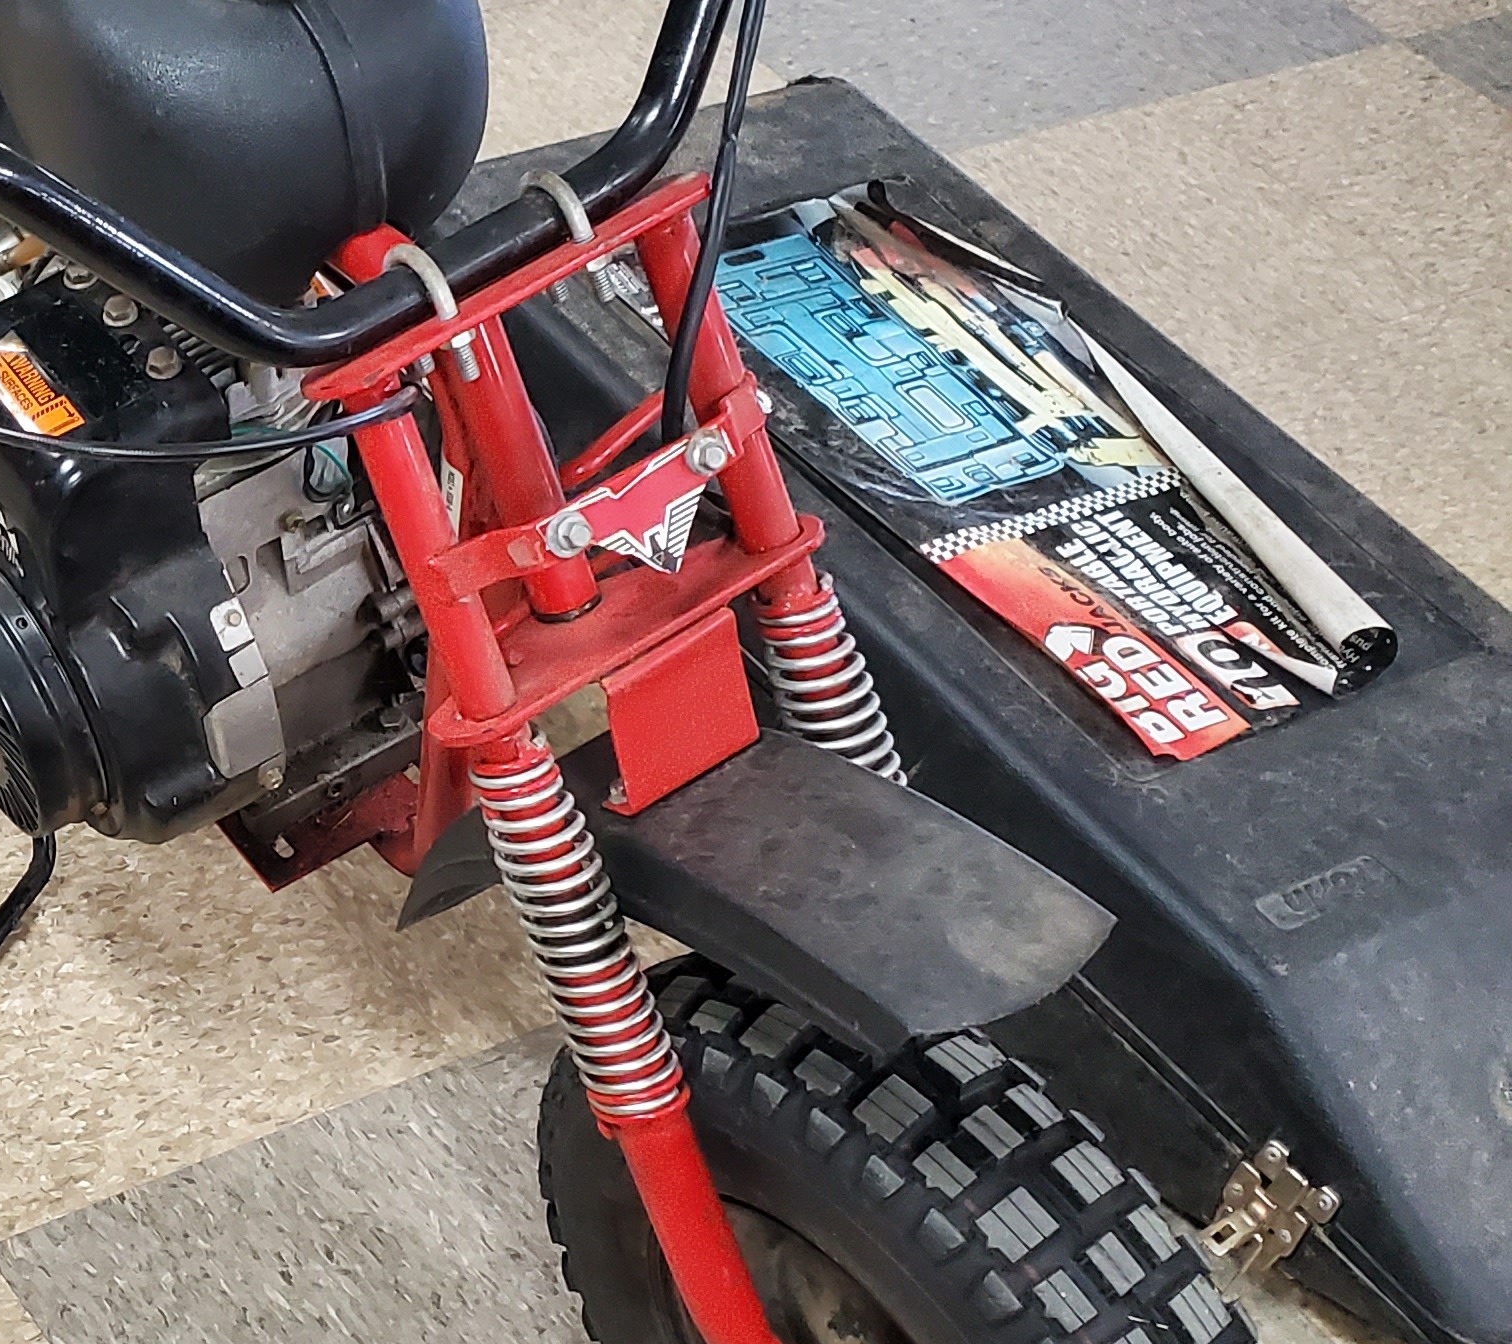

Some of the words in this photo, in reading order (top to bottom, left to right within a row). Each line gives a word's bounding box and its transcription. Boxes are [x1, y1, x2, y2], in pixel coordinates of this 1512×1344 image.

[0, 369, 34, 411] SURFACES
[9, 354, 56, 404] WARNING
[1175, 535, 1202, 554] auto
[1176, 521, 1205, 544] jobs.
[1093, 509, 1239, 626] EQUIPMENT
[1197, 553, 1214, 564] of
[1200, 542, 1265, 595] construction
[1211, 564, 1248, 595] variety
[1037, 565, 1128, 633] JACKS
[1055, 537, 1188, 636] PORTABLE
[1247, 593, 1258, 601] a
[1254, 602, 1273, 617] for
[1269, 615, 1288, 631] kit
[1074, 660, 1186, 744] BIG
[1101, 635, 1230, 733] RED
